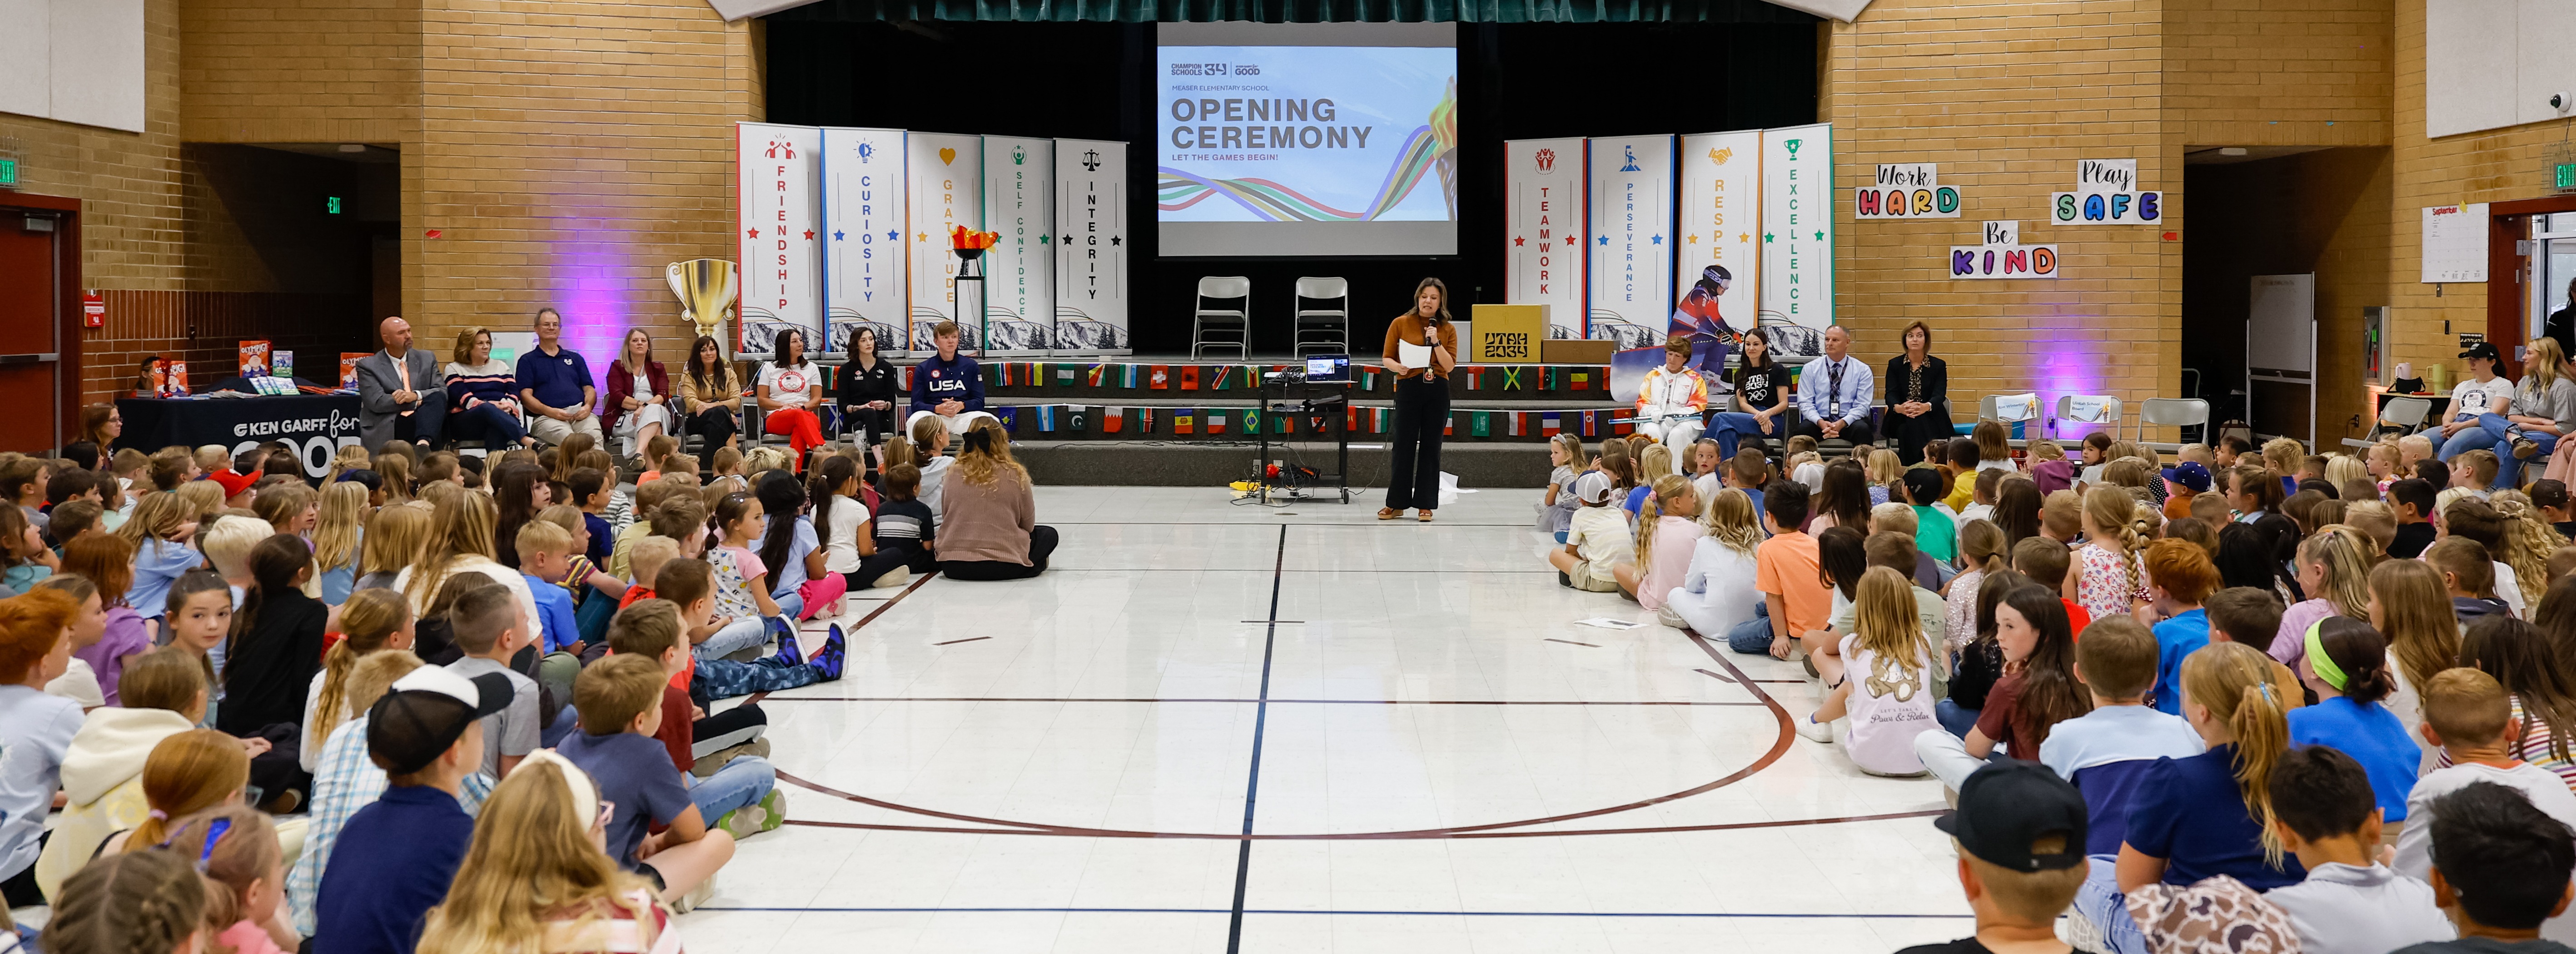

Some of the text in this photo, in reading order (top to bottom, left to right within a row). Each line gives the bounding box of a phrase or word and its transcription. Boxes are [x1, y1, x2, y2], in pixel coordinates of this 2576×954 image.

[1171, 98, 1335, 122] OPENING
[1171, 126, 1373, 149] CEREMONY
[0, 160, 14, 183] XIT
[1877, 164, 1931, 187] Work
[2082, 160, 2133, 192] Play
[329, 197, 340, 214] EXIT
[1859, 187, 1959, 216] HARD
[2057, 193, 2159, 221] SAFE
[2432, 207, 2457, 216] September
[1713, 179, 1724, 263] RESPE
[777, 166, 787, 310] FRIENDSHIP
[861, 176, 873, 302] CURIOSITY
[943, 179, 954, 302] GRATITUDE
[1088, 181, 1096, 299] INTEGRITY
[1539, 188, 1551, 294] TEAMWORK
[1789, 169, 1799, 314] EXCELLENCE
[1986, 222, 2013, 245] Be
[1017, 217, 1025, 315] CONFIDENCE
[1953, 248, 2056, 275] KIND
[241, 343, 267, 353] OLYMPIG!
[1485, 333, 1527, 344] UTAH
[342, 356, 369, 365] OLYM
[1485, 346, 1527, 358] 2034
[155, 363, 185, 374] OLPIG!
[929, 380, 966, 392] USA
[250, 409, 360, 438] KEN GARFF for
[1870, 711, 1930, 724] Paws & Relax
